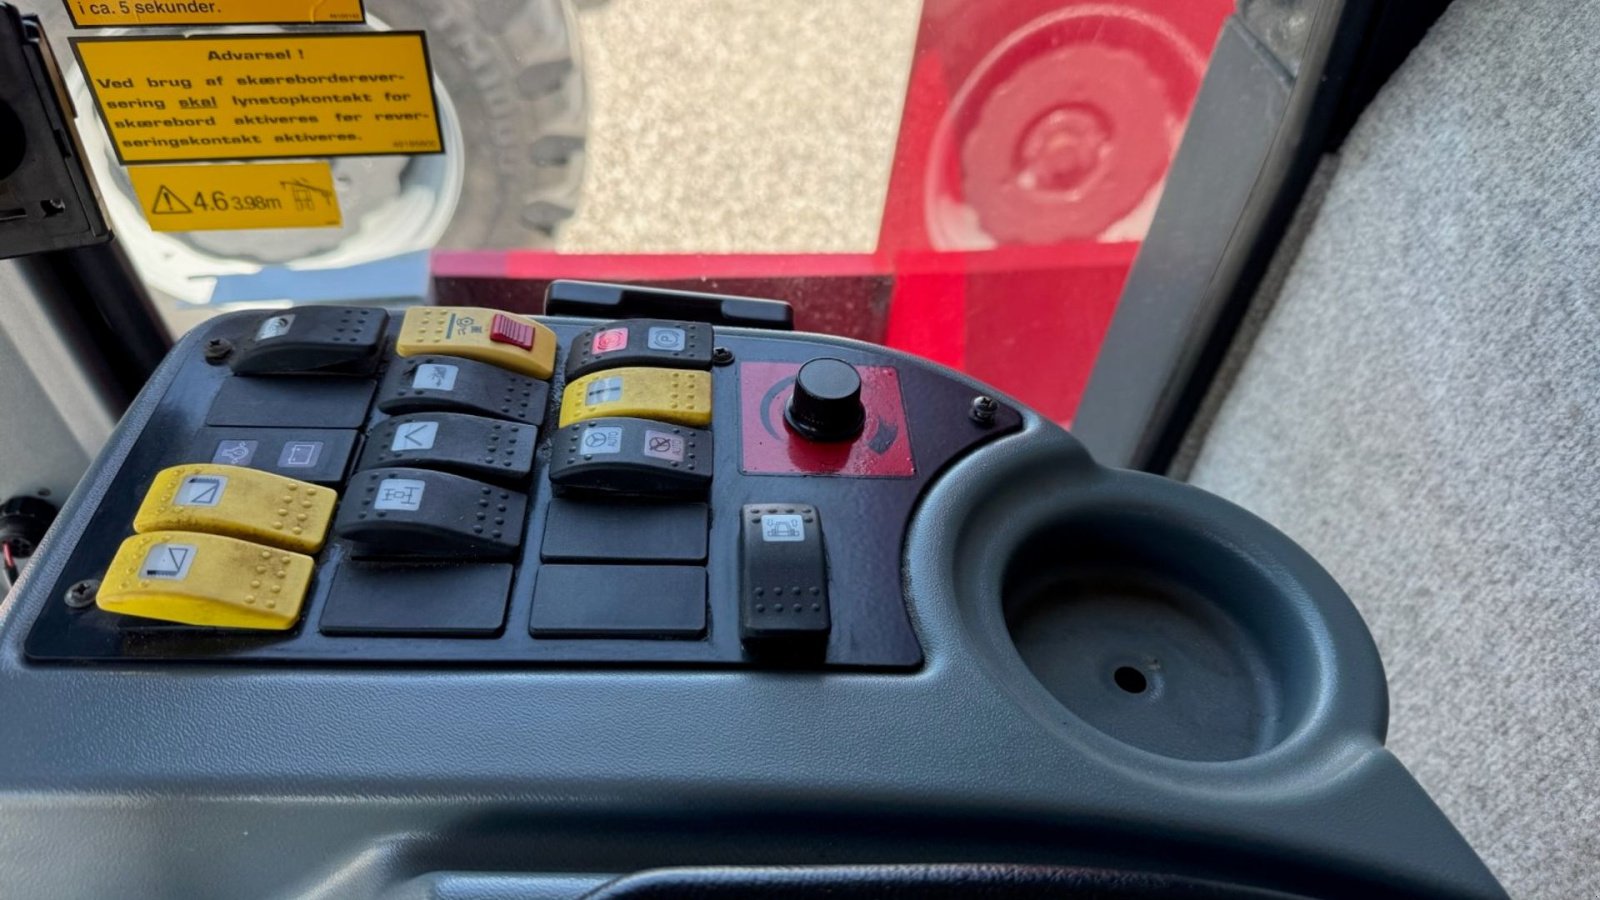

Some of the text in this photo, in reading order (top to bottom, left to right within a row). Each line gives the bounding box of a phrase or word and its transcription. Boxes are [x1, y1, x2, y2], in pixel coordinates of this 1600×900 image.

[79, 0, 221, 14] i ca. 5 sekunder.
[208, 48, 304, 60] Advarsel !
[97, 73, 405, 89] Ved brug af skærebordsrever-
[107, 92, 411, 110] sering skal lynstopkontakt for
[115, 116, 215, 128] skærebord
[234, 113, 319, 125] aktiveres
[375, 110, 430, 121] rever-
[122, 132, 362, 148] seringskontakt aktiveres.
[194, 191, 282, 211] 4.6 3.98m
